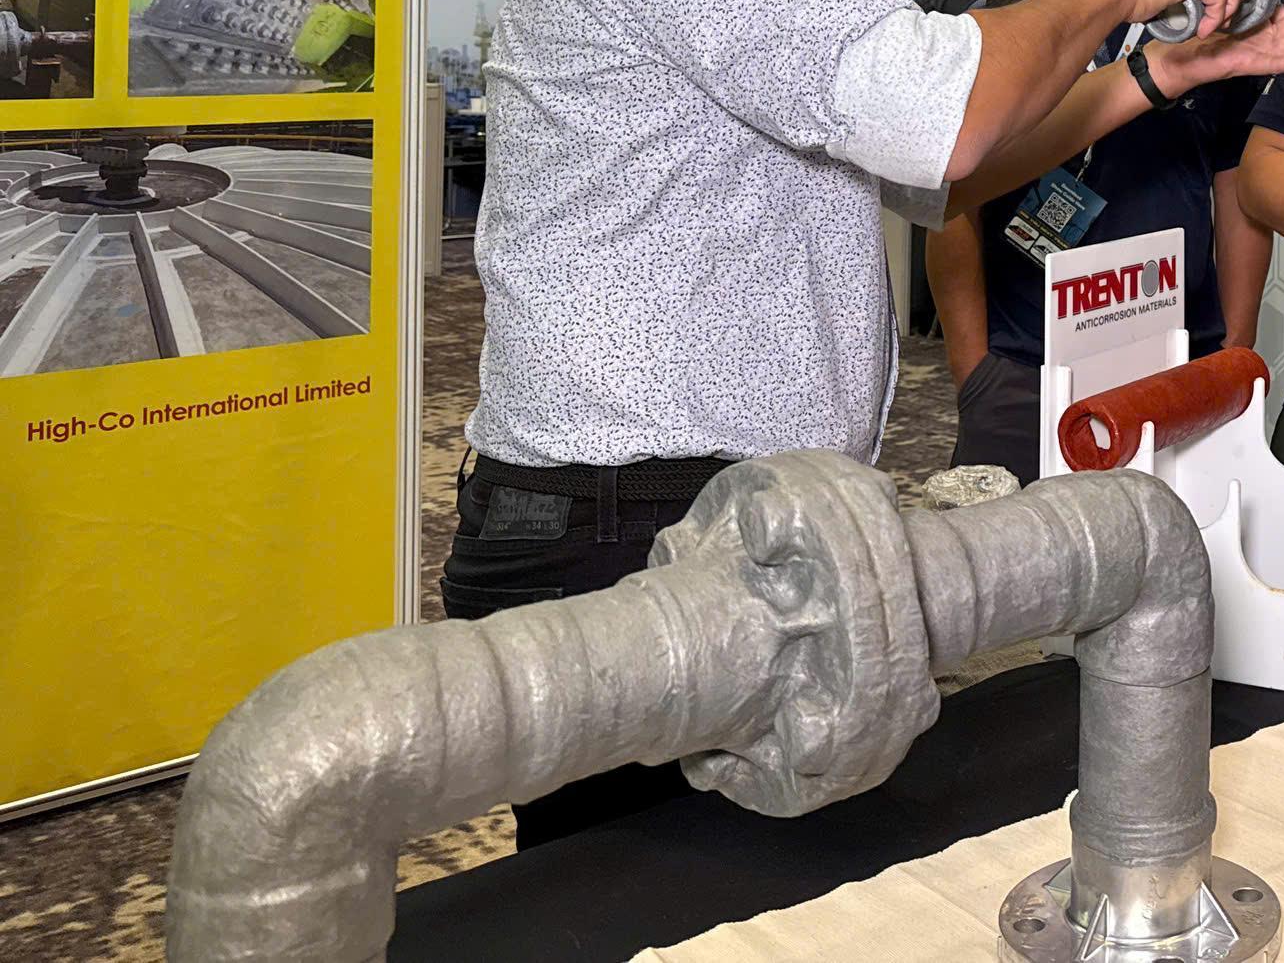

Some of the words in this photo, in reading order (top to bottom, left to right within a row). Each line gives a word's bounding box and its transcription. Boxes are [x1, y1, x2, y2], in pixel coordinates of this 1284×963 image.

[1052, 255, 1177, 320] TRENTON
[1075, 307, 1137, 332] ANTICORROSION
[1138, 296, 1177, 314] MATERIALS
[27, 411, 135, 443] High-Co
[143, 387, 288, 426] International
[295, 376, 371, 403] Limited
